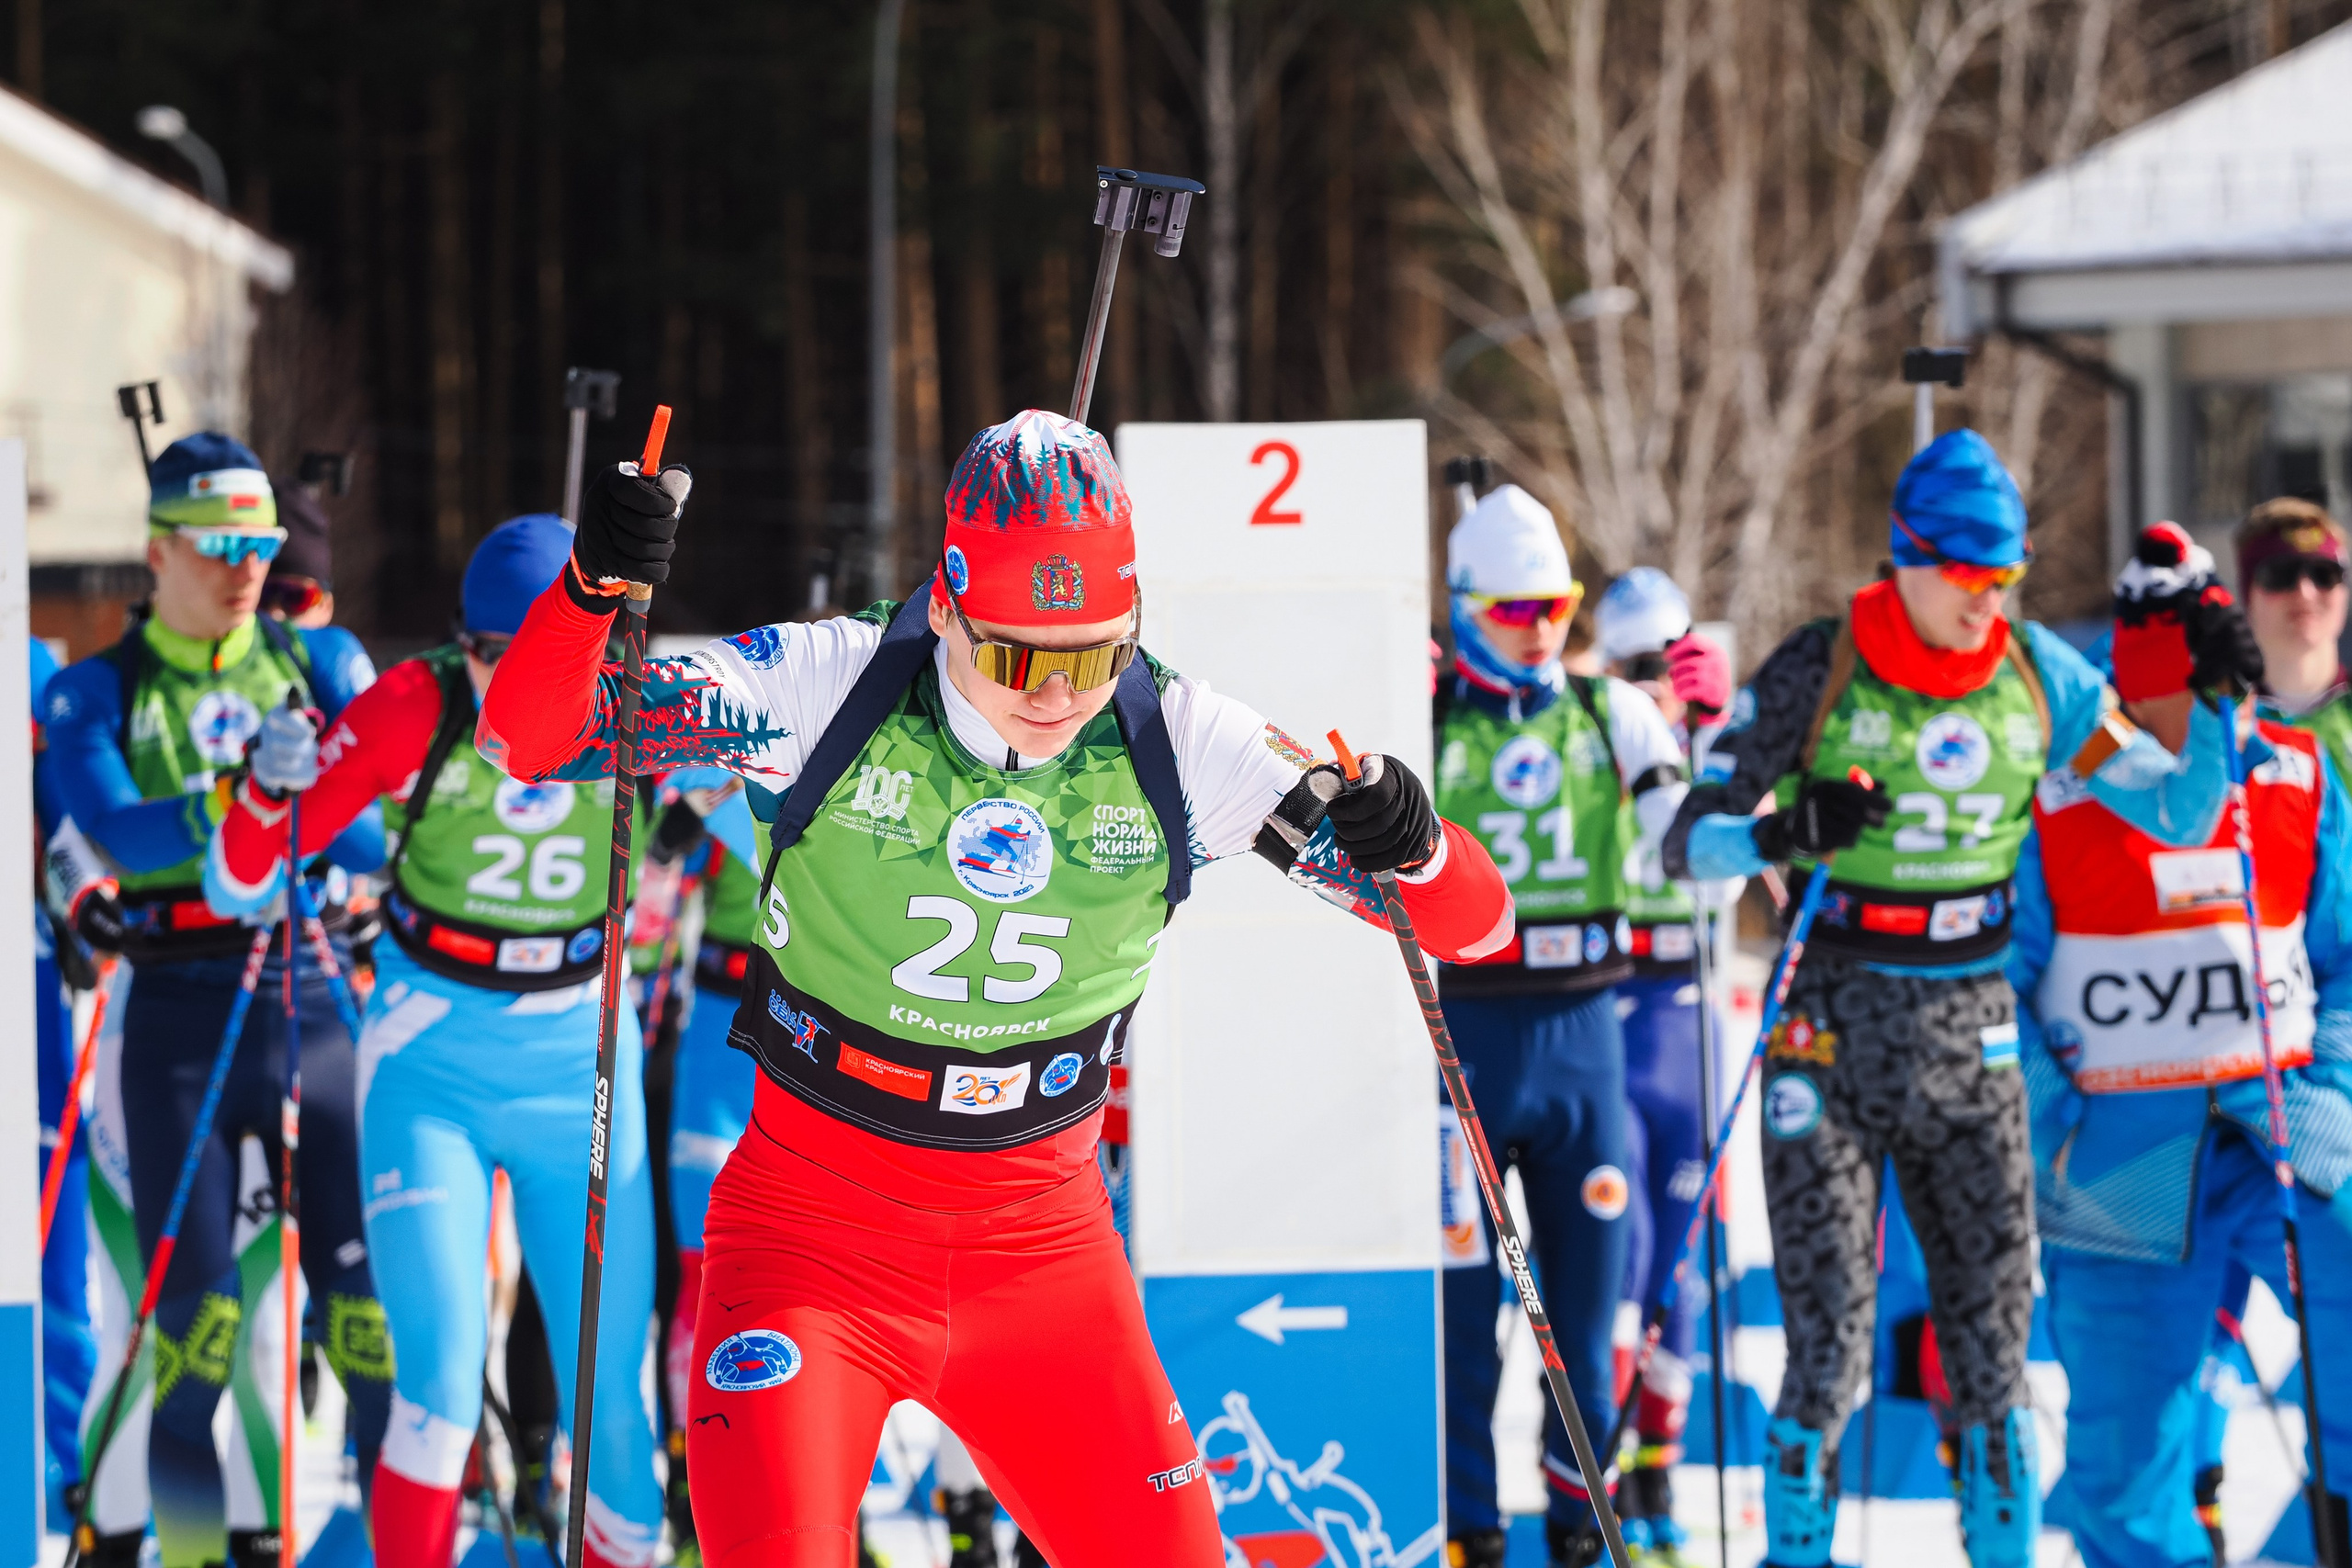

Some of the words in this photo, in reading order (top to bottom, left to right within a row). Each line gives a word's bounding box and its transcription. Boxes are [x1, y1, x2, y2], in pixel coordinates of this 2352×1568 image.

[1250, 441, 1301, 525] 2
[899, 784, 914, 793] ЛЕТ
[834, 810, 890, 830] МИНИСТЕРСТВО
[891, 825, 920, 837] СПОРТА
[961, 800, 1018, 821] ПЕРВЕСТВО
[1018, 805, 1046, 834] РОССИИ
[1093, 804, 1147, 823] СПОРТ
[1893, 791, 2006, 853] 27
[829, 815, 875, 835] РОССИЙСКОЙ
[875, 829, 922, 845] ФЕДЕРАЦИИ
[1092, 821, 1158, 840] НОРМА
[1476, 805, 1589, 885] 31
[1090, 853, 1155, 865] ФЕДЕРАЛЬНЫЙ
[1091, 838, 1158, 855] ЖИЗНИ
[466, 834, 587, 901] 26
[1090, 865, 1125, 874] ПРОЕКТ
[963, 874, 1010, 899] Красноярск
[1012, 884, 1035, 897] 2023
[890, 894, 1072, 1004] 25
[888, 1003, 1051, 1041] КРАСНОЯРСК
[865, 1057, 926, 1080] КРАСНОЯРСКИЙ
[865, 1063, 884, 1076] КРАЙ
[590, 1070, 608, 1181] SPHERE
[1502, 1235, 1544, 1314] SPHERE
[707, 1337, 734, 1375] АКАДЕМИЯ
[766, 1331, 800, 1362] БИАТЛОНА
